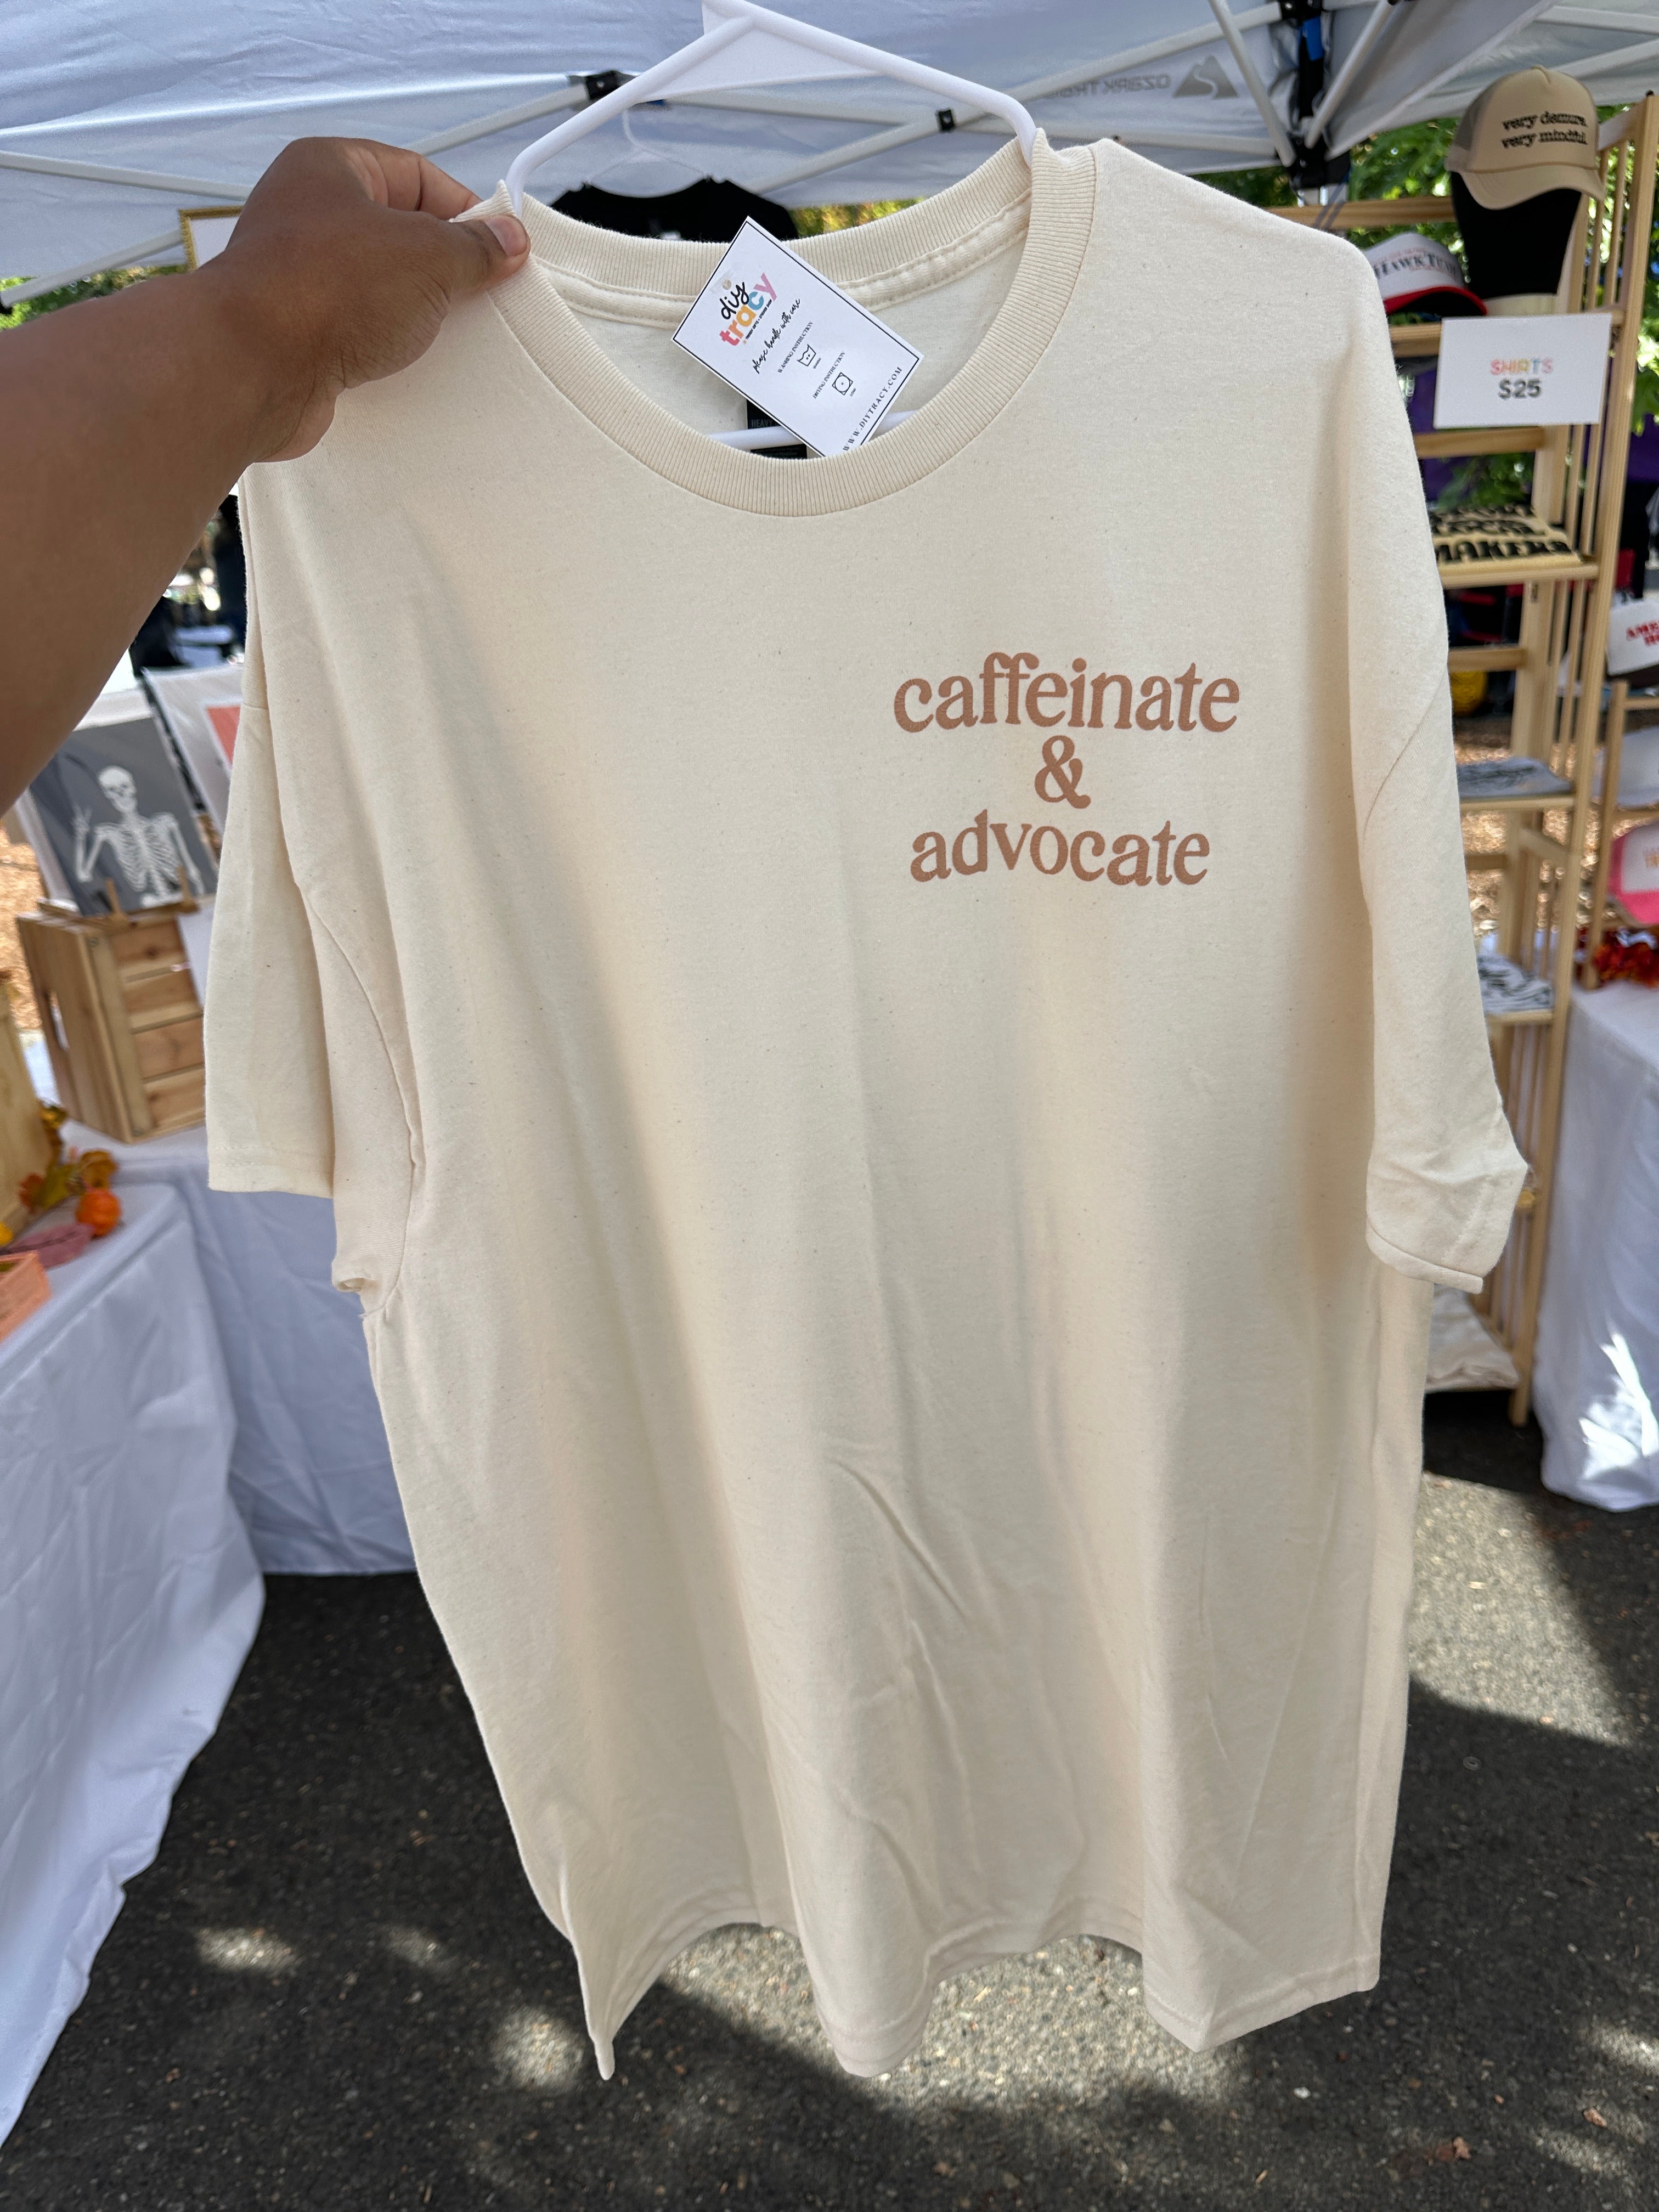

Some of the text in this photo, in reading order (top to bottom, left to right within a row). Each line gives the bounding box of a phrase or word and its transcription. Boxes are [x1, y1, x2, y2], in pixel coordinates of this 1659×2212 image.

[1501, 133, 1537, 149] very
[1502, 115, 1538, 131] very
[719, 273, 777, 346] tracy
[720, 281, 750, 320] diy
[752, 298, 800, 374] please handle with care
[777, 321, 813, 373] WASHING INSTRUCTION
[812, 352, 845, 399] DRYING INSTRUCTION
[1490, 358, 1554, 375] SHIRTS
[1498, 378, 1542, 399] $25
[751, 419, 773, 427] HEAVY
[842, 366, 902, 450] WWW.DIYTRACY.COM
[893, 652, 1240, 733] caffeinate
[1034, 735, 1092, 809] &
[910, 809, 1210, 887] advocate
